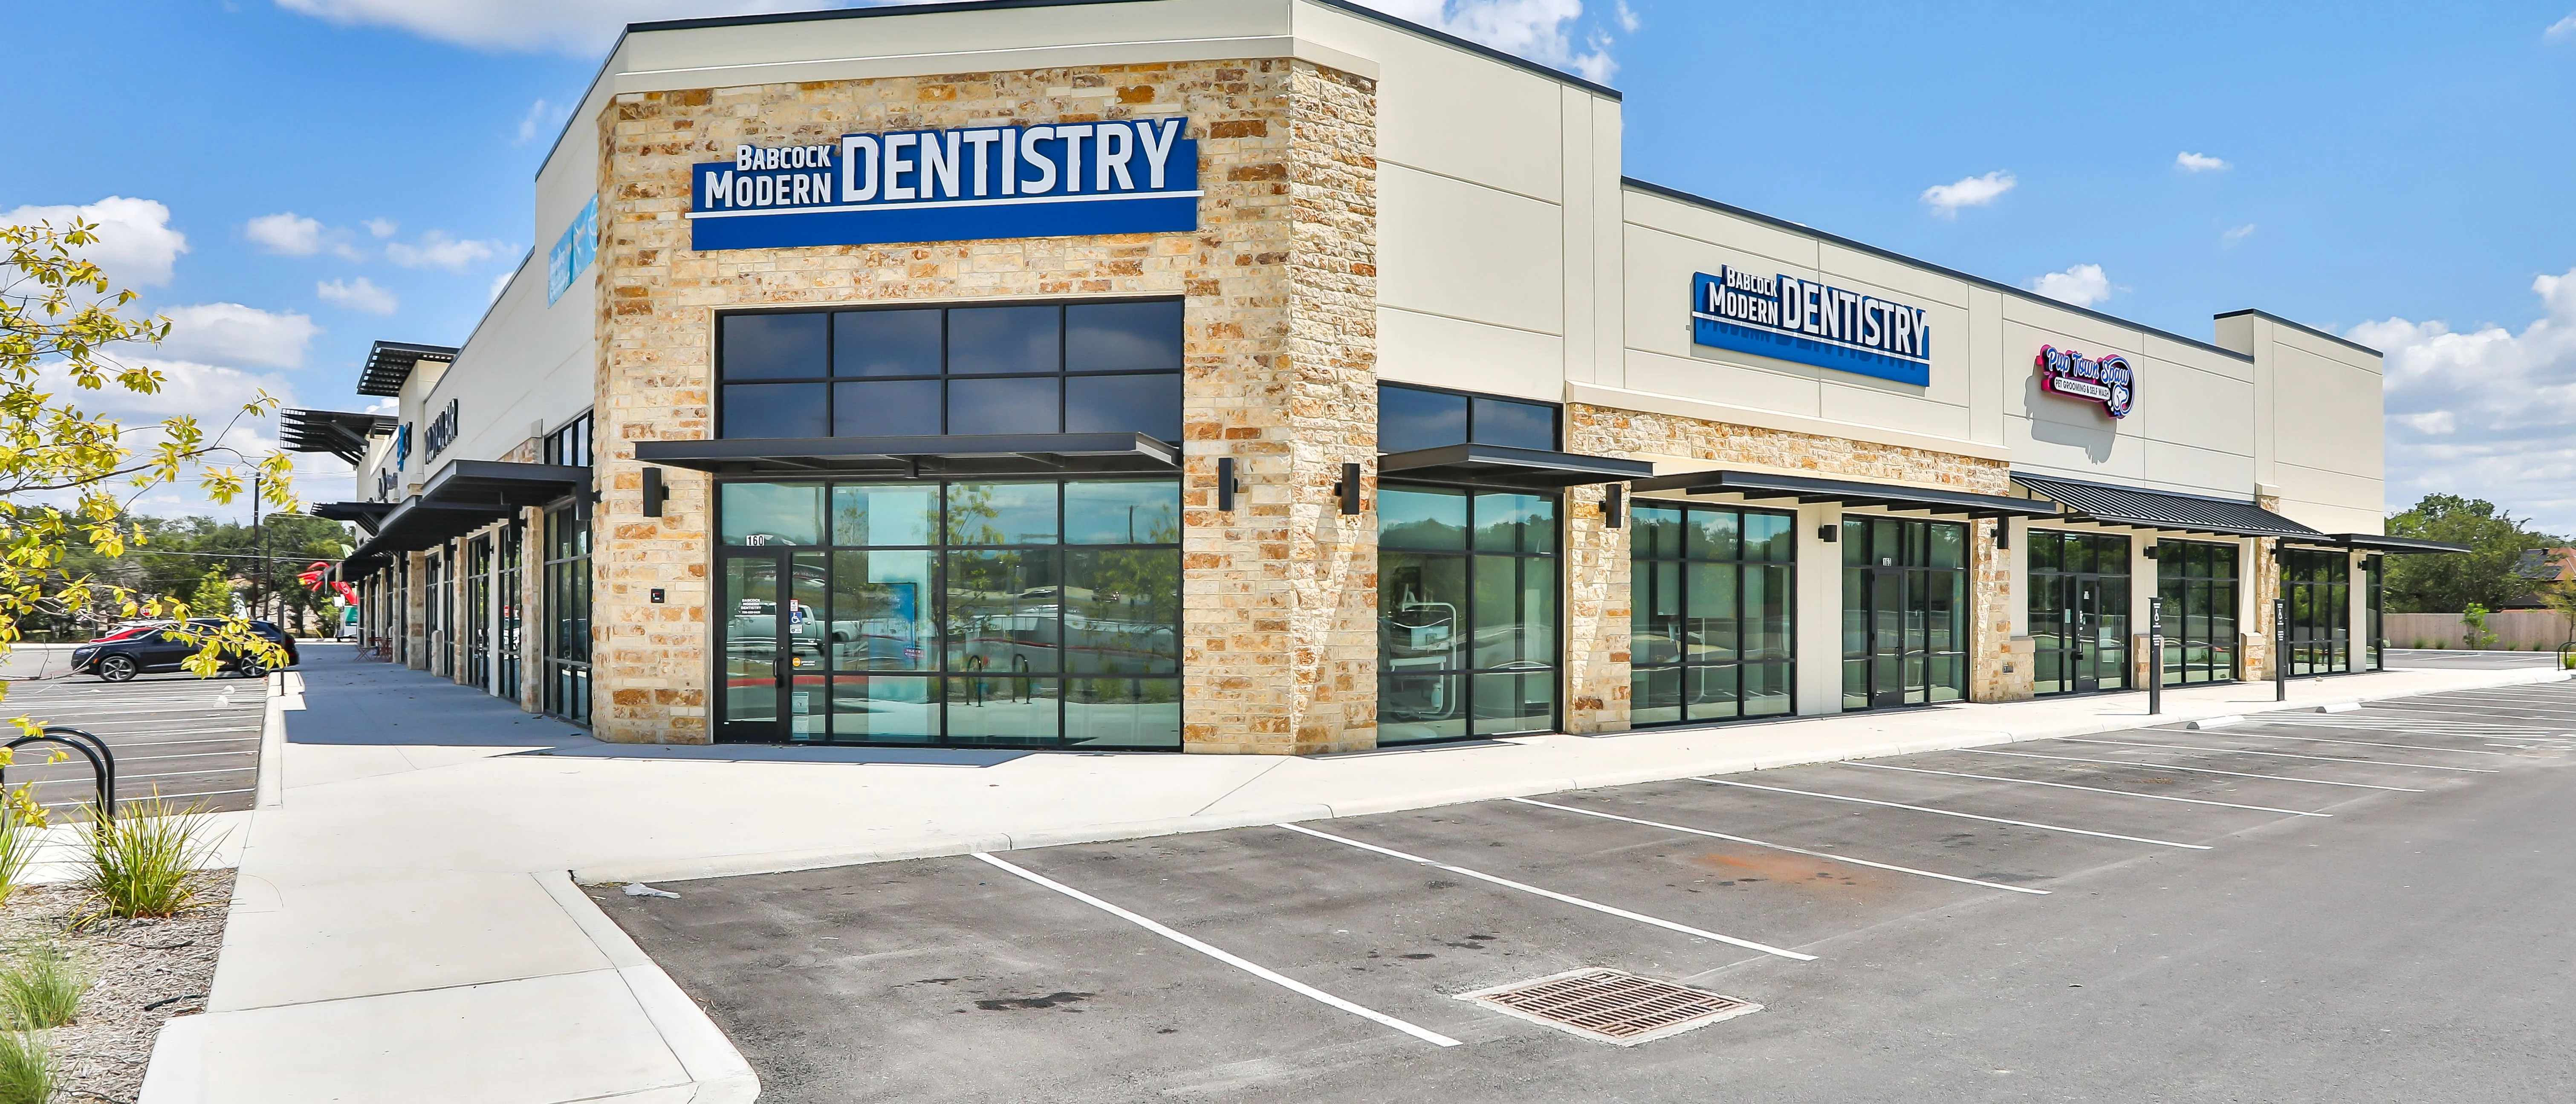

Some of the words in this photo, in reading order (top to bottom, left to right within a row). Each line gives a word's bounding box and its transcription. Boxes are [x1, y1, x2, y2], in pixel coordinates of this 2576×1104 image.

[842, 120, 1180, 203] DENTISTRY
[1782, 277, 1927, 356] DENTISTRY
[2047, 347, 2070, 378] Pup
[2072, 353, 2099, 380] Town
[2101, 360, 2130, 388] Spaw
[2063, 380, 2087, 393] GROOMING
[2099, 389, 2109, 398] WASH
[748, 536, 763, 546] 160
